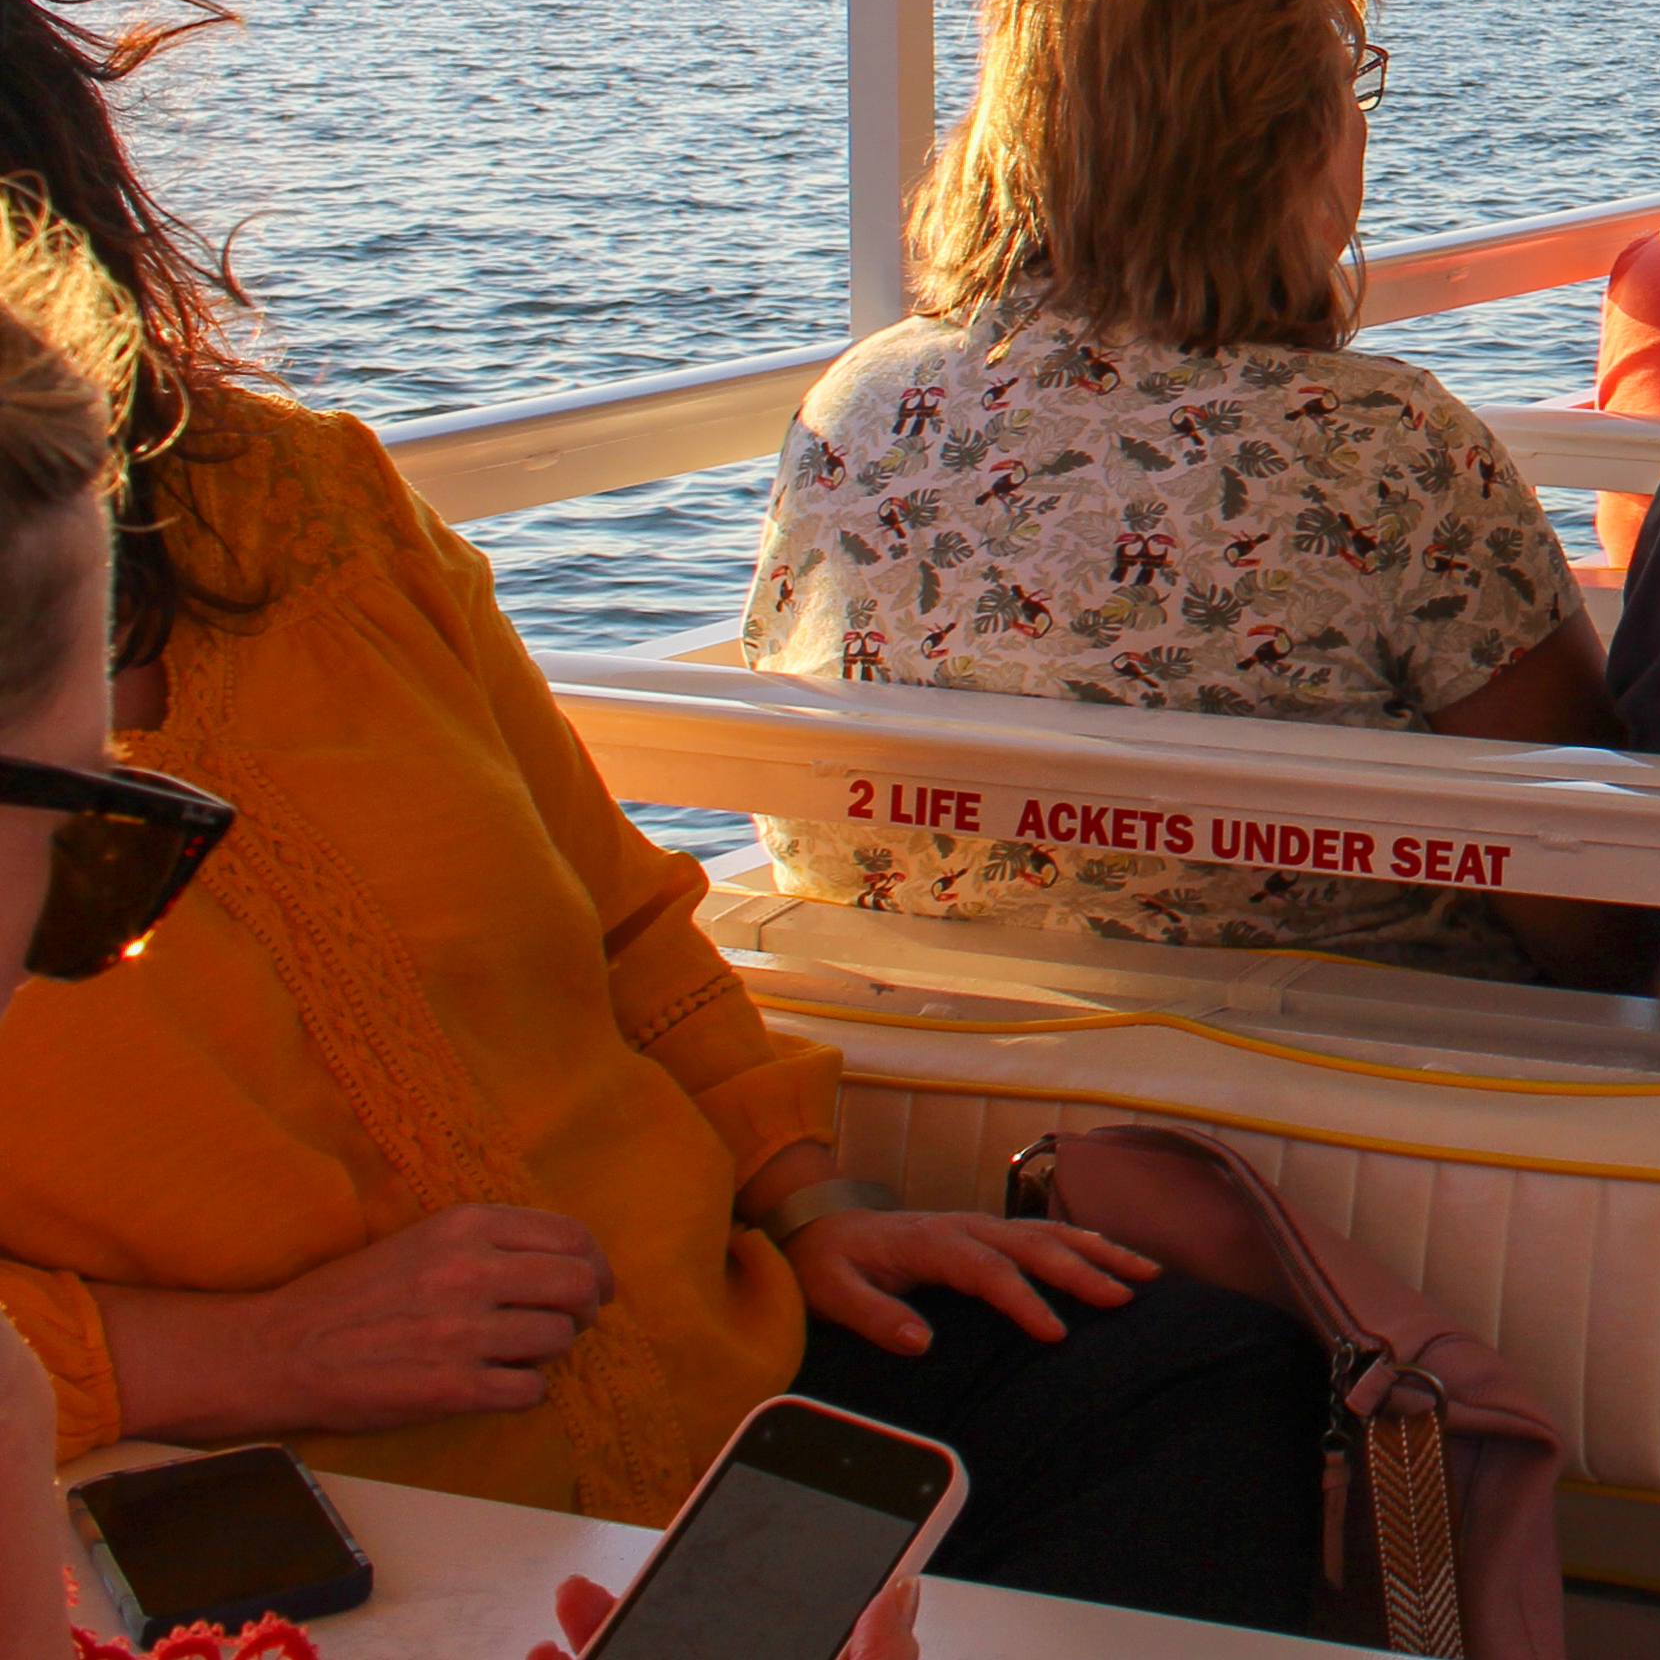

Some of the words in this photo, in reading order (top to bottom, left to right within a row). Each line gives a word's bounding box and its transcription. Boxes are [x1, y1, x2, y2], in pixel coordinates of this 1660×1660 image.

[846, 779, 876, 820] 2
[890, 783, 983, 833] LIFE
[1211, 818, 1375, 873] UNDER
[1390, 836, 1512, 886] SEAT
